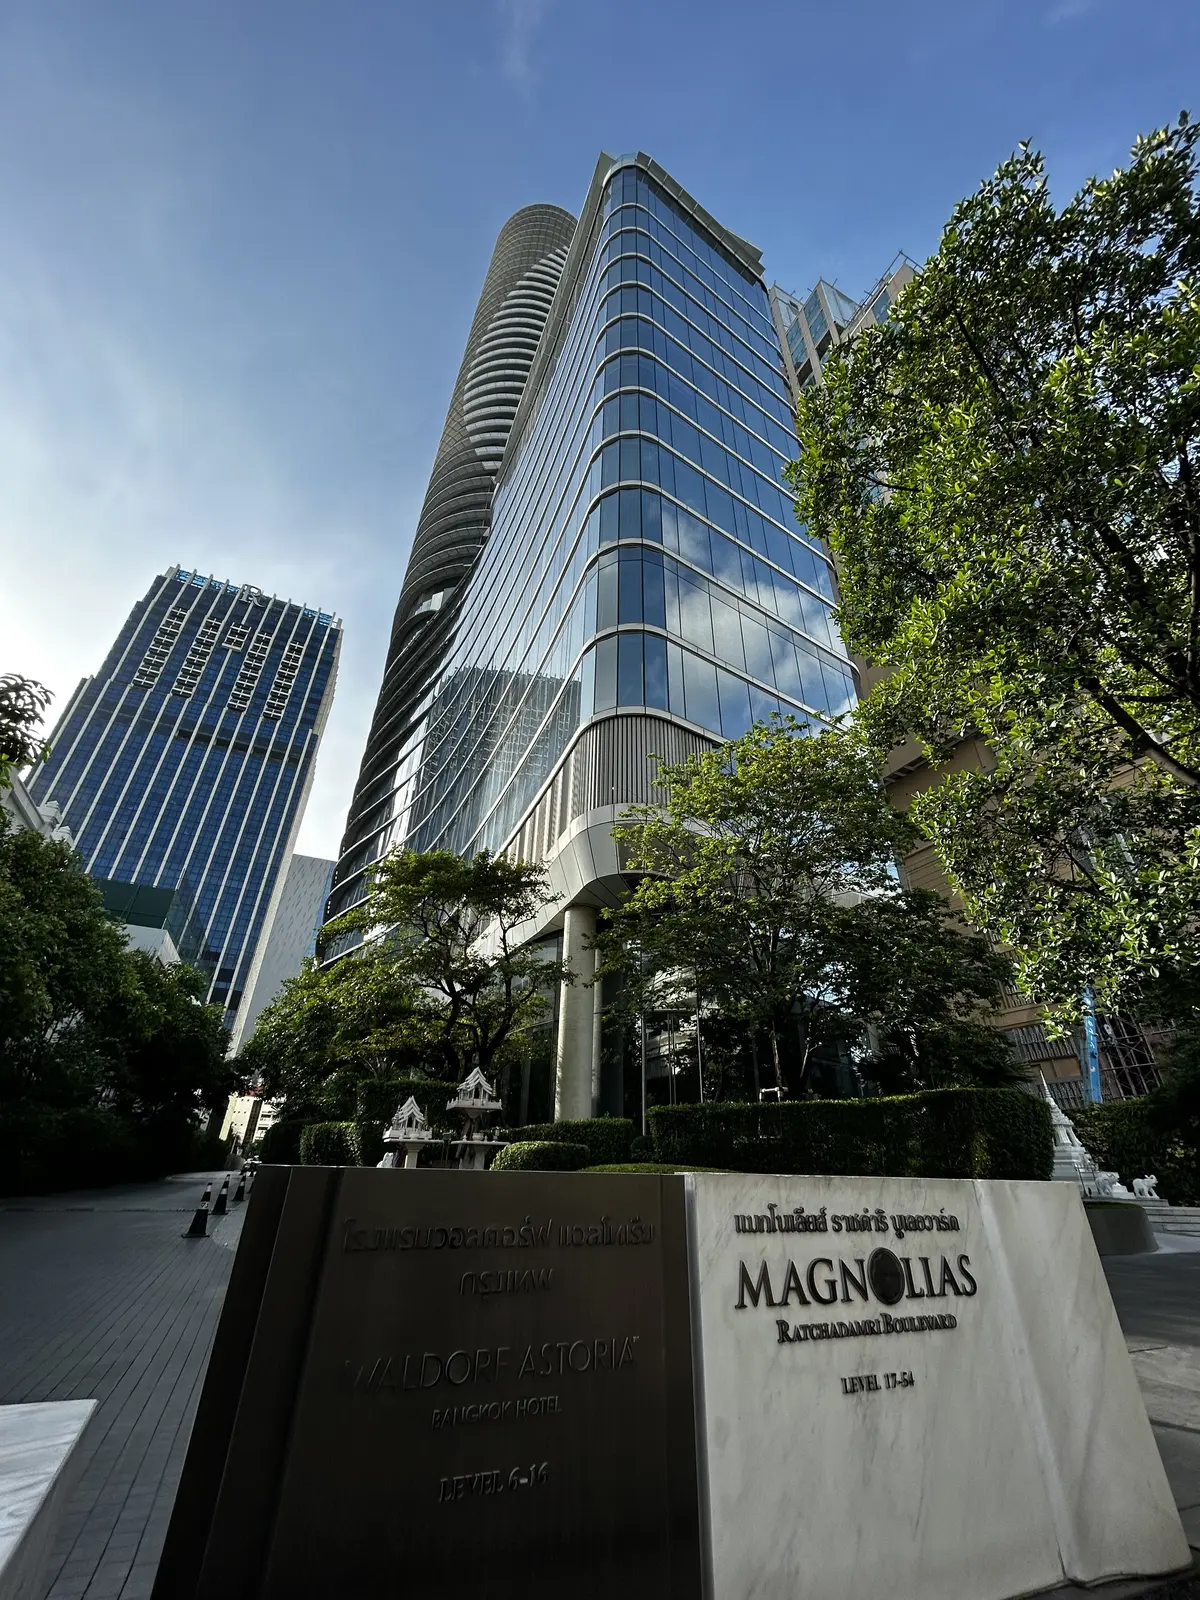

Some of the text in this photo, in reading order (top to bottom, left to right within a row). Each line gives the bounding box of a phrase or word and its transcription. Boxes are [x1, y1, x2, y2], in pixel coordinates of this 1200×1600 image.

[831, 1208, 889, 1233] ราชดำริ
[891, 1208, 960, 1239] บูเลอวาร์ด
[459, 1268, 555, 1304] กรุงเทพ
[734, 1247, 978, 1309] MAGNOLIAS
[776, 1313, 957, 1343] RATCHADAMRI BOULEVARD
[343, 1346, 511, 1395] WALDORF
[841, 1371, 915, 1394] LEVEL 17-54
[431, 1394, 563, 1430] BANGKOK HOTEL
[438, 1461, 550, 1504] LEVEL 6-16
